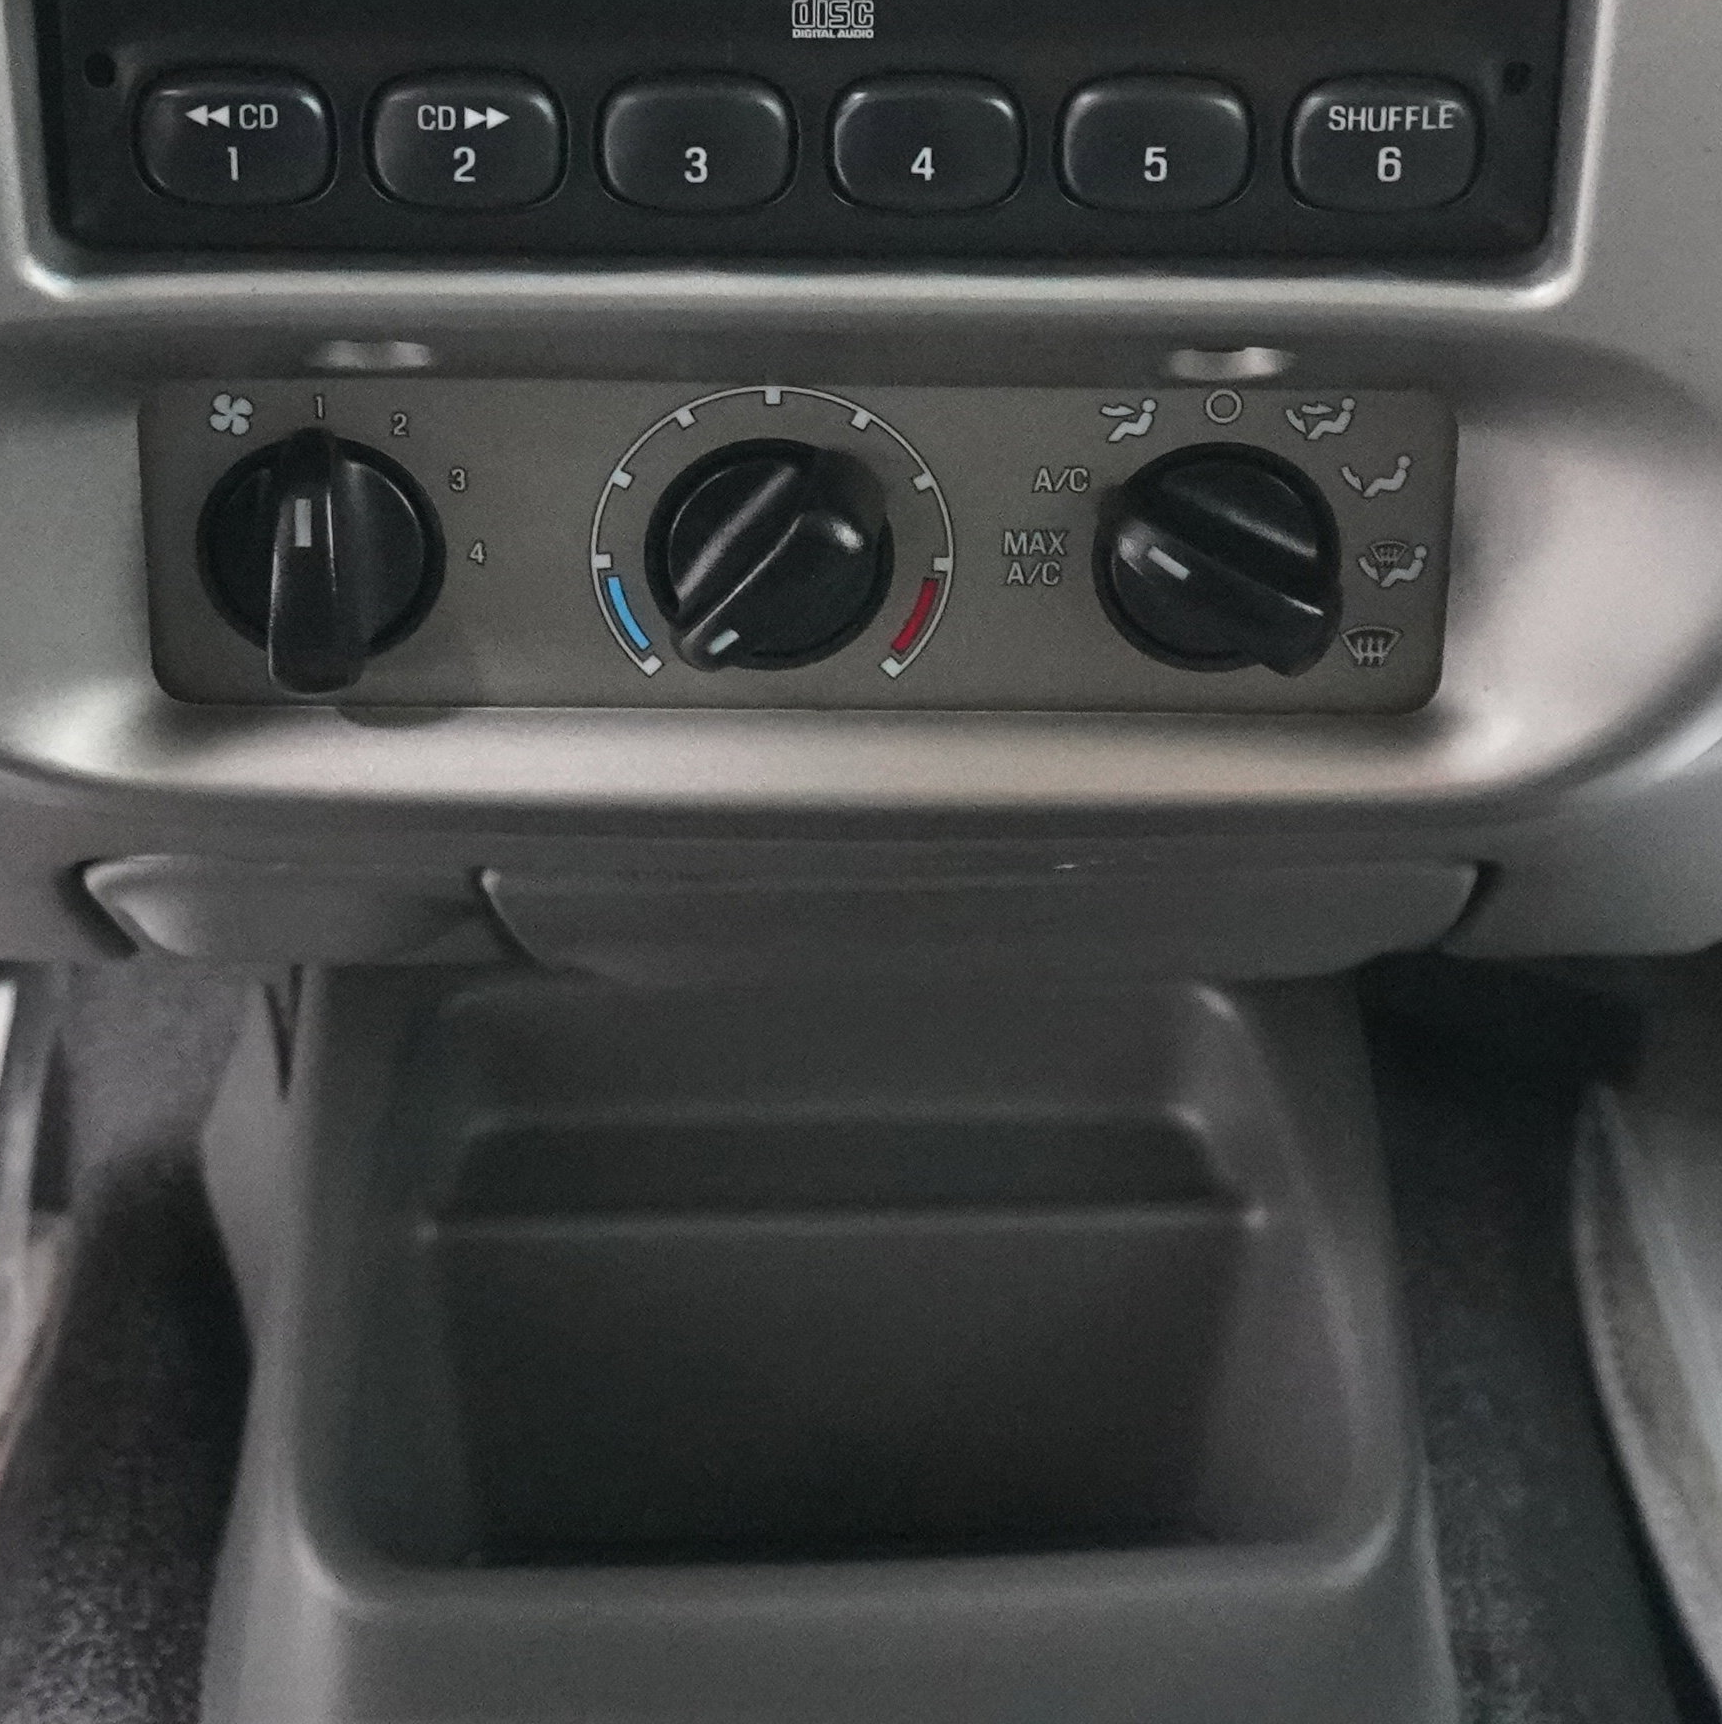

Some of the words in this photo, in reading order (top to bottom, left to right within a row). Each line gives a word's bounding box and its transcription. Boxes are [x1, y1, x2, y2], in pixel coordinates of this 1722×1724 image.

[792, 28, 837, 39] DIGITAL
[837, 28, 875, 39] AUDIO
[238, 104, 278, 131] CD
[417, 105, 457, 132] CD
[1328, 105, 1455, 132] SHUFFLE
[227, 146, 240, 181] 1
[452, 146, 477, 183] 2
[684, 146, 709, 184] 3
[910, 147, 936, 182] 4
[1143, 147, 1168, 183] 5
[1377, 146, 1403, 183] 6
[313, 395, 326, 420] 1
[392, 413, 409, 437] 2
[449, 468, 467, 492] 3
[1033, 467, 1090, 493] A/C
[468, 542, 488, 566] 4
[1002, 531, 1067, 557] MAX
[1006, 561, 1062, 587] A/C
